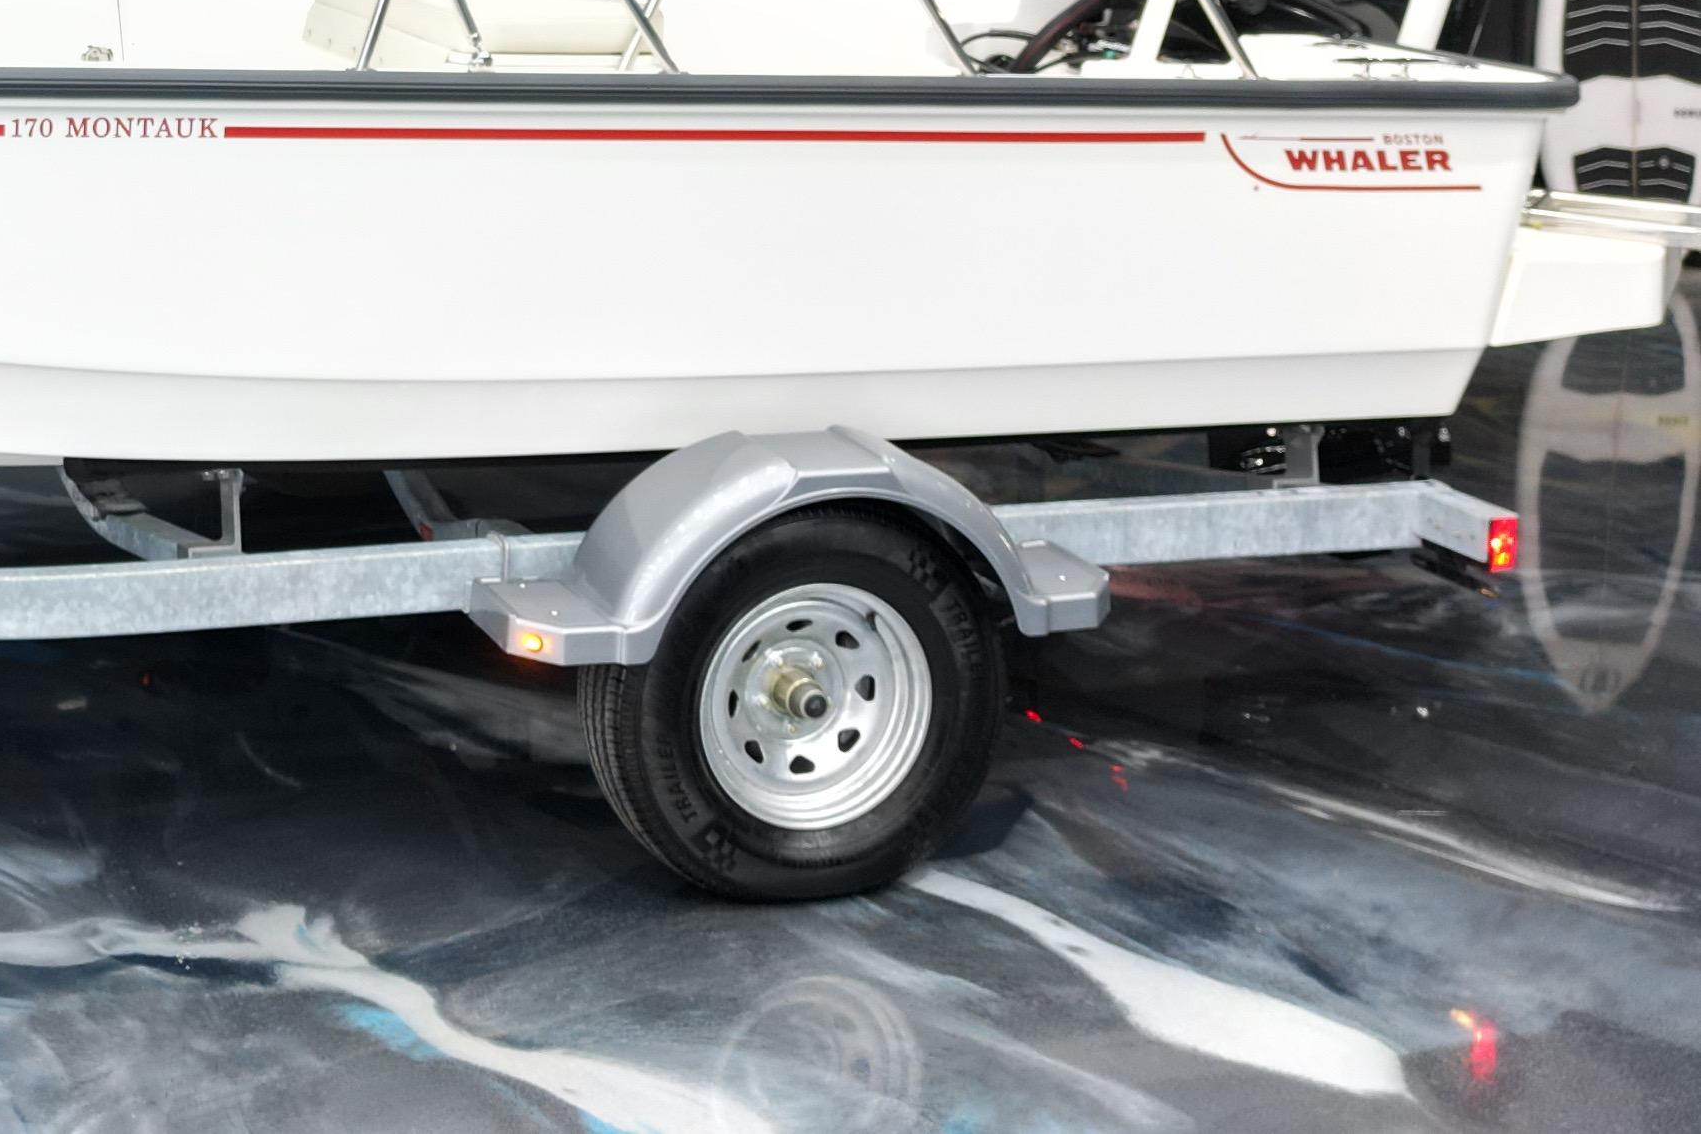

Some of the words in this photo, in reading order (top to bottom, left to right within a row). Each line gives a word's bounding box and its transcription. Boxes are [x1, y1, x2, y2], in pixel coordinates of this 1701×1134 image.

[11, 117, 54, 138] 170
[65, 117, 218, 139] MONTAUK
[1383, 133, 1444, 145] BOSTON
[1285, 149, 1452, 171] WHALER
